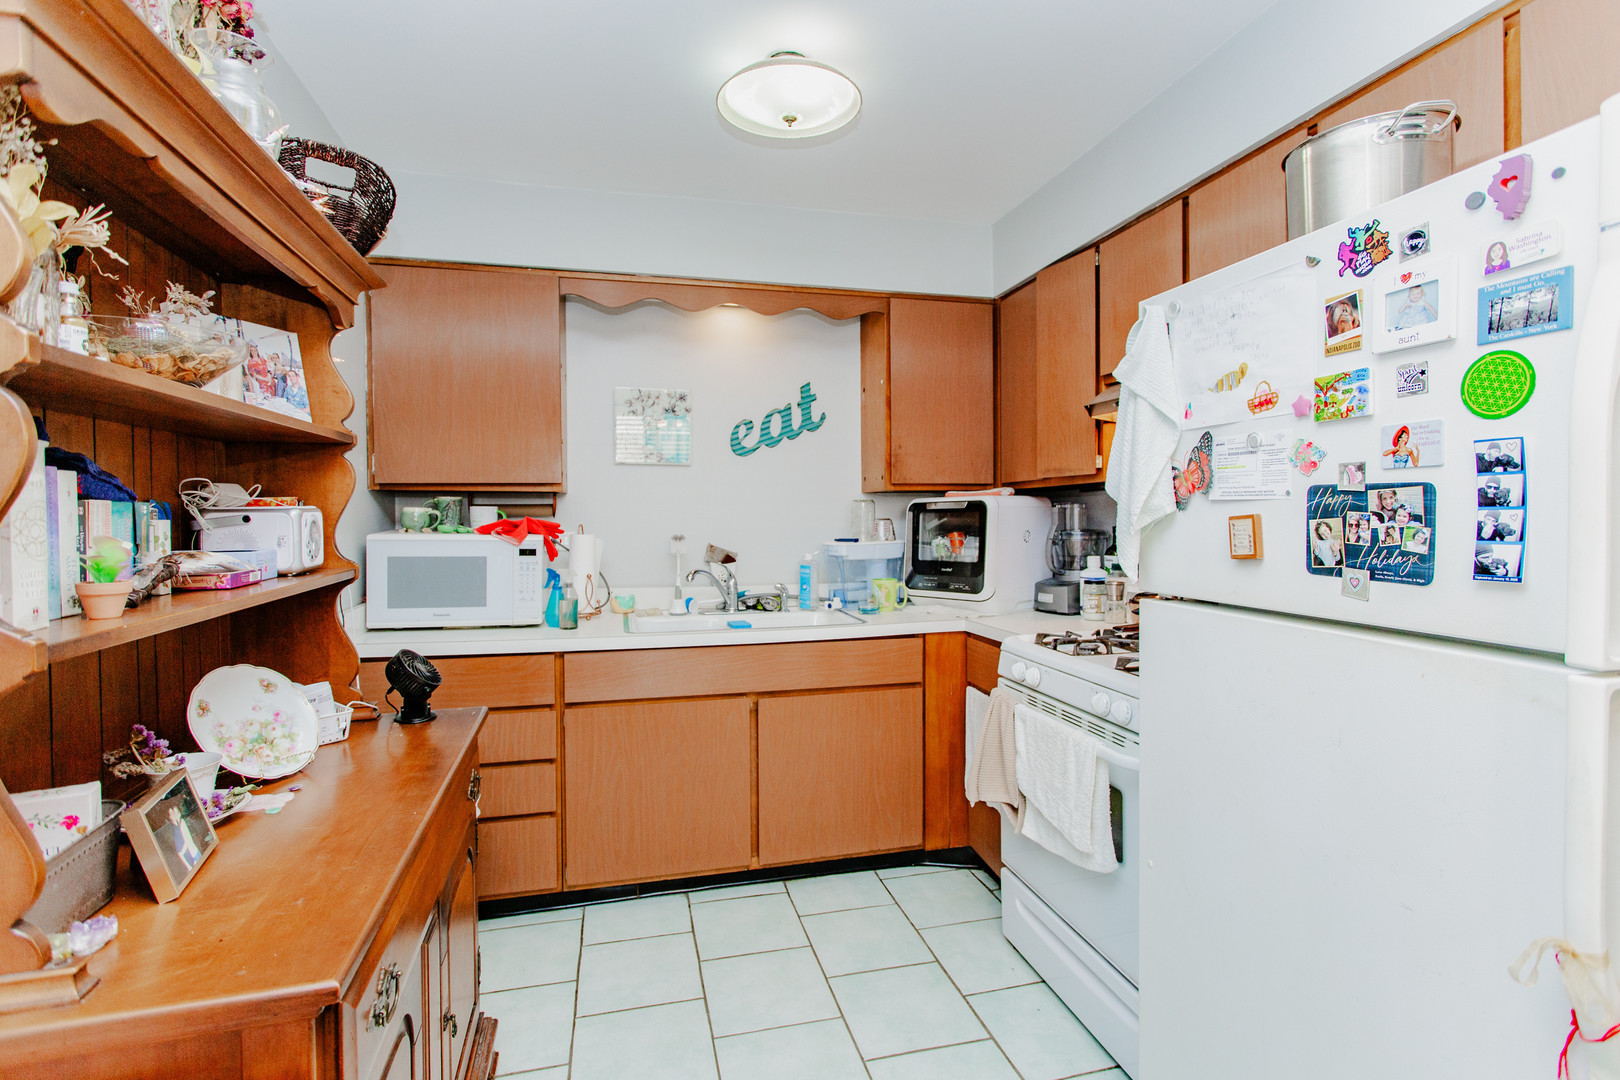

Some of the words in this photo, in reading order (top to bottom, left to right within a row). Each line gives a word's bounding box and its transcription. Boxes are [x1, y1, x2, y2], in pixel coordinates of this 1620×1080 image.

[1508, 234, 1552, 252] Washington
[1515, 231, 1543, 244] Sabrina
[1414, 271, 1427, 280] my
[1496, 278, 1528, 289] Mountains
[1541, 268, 1566, 279] Calling
[1517, 283, 1532, 291] must
[1398, 332, 1420, 345] aunt
[1499, 329, 1524, 338] Catskills
[1325, 342, 1352, 354] INDIANAPOLIS
[1353, 340, 1361, 349] ZOO
[730, 381, 826, 457] eat
[1308, 487, 1362, 518] Happy
[1348, 542, 1428, 576] Holidays
